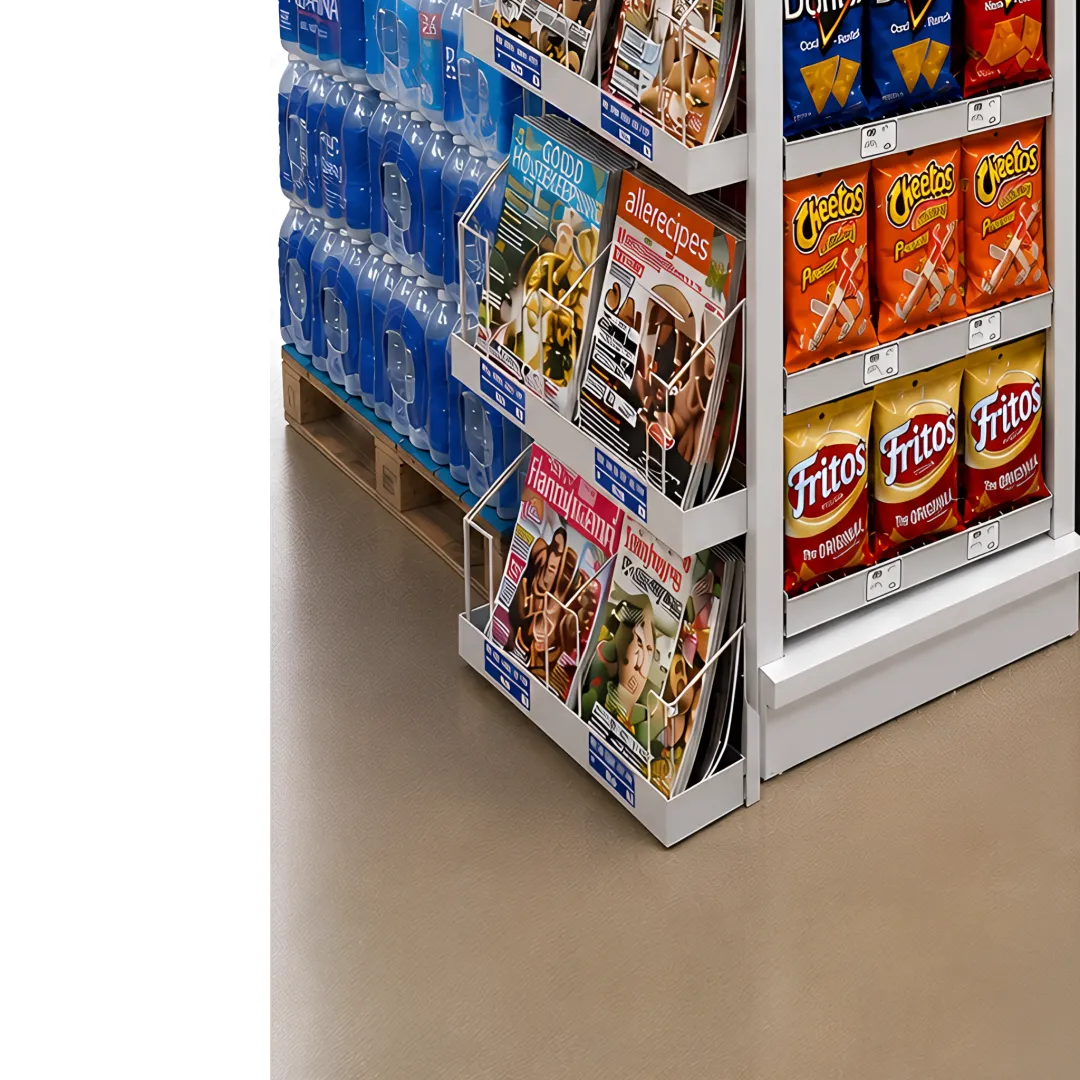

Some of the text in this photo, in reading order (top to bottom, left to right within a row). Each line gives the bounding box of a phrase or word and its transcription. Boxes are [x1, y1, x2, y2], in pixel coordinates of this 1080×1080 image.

[886, 160, 955, 228] Cheetos
[974, 141, 1038, 206] Cheetos
[793, 180, 864, 253] Cheetos
[879, 411, 956, 486] Fritos
[971, 380, 1042, 452] Fritos
[787, 441, 867, 519] Fritos
